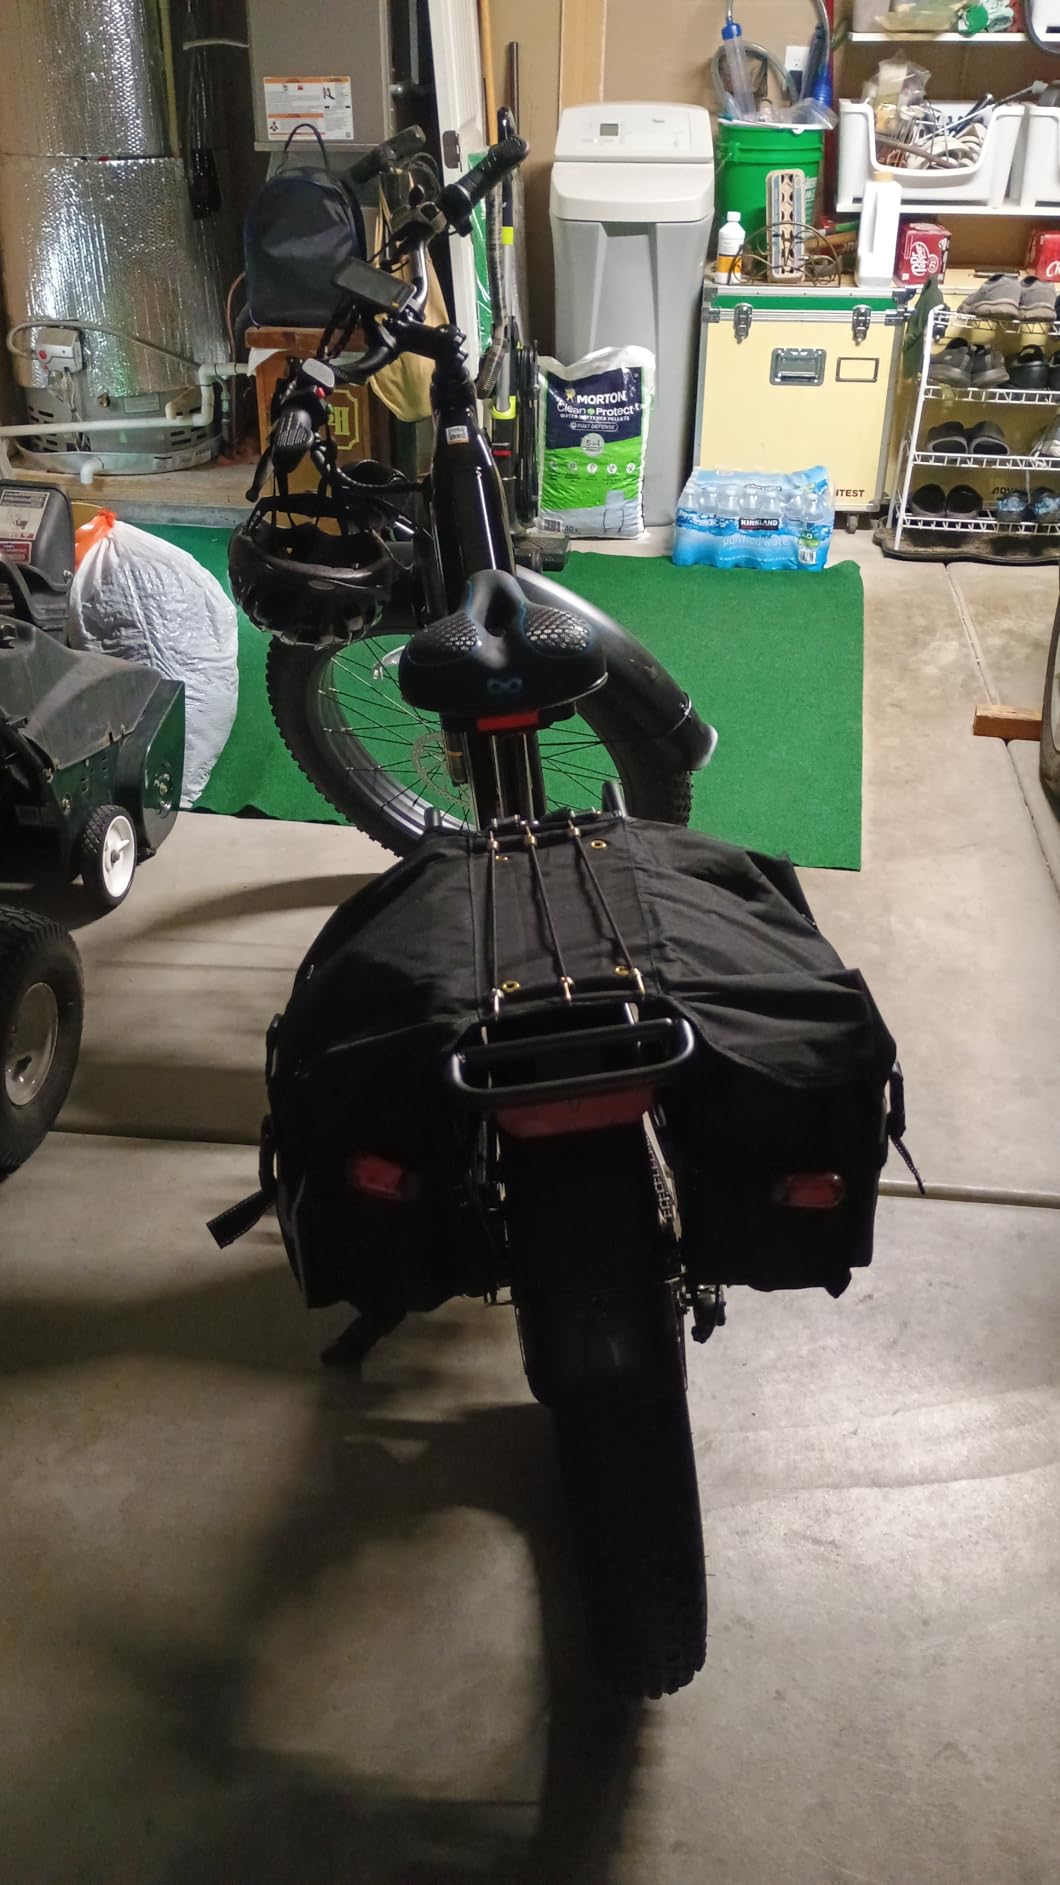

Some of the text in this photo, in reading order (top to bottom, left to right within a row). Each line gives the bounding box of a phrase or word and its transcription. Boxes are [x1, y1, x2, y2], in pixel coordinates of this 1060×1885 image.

[576, 390, 628, 405] MORTON
[557, 402, 586, 415] Clean
[740, 519, 778, 527] KIRKLAND
